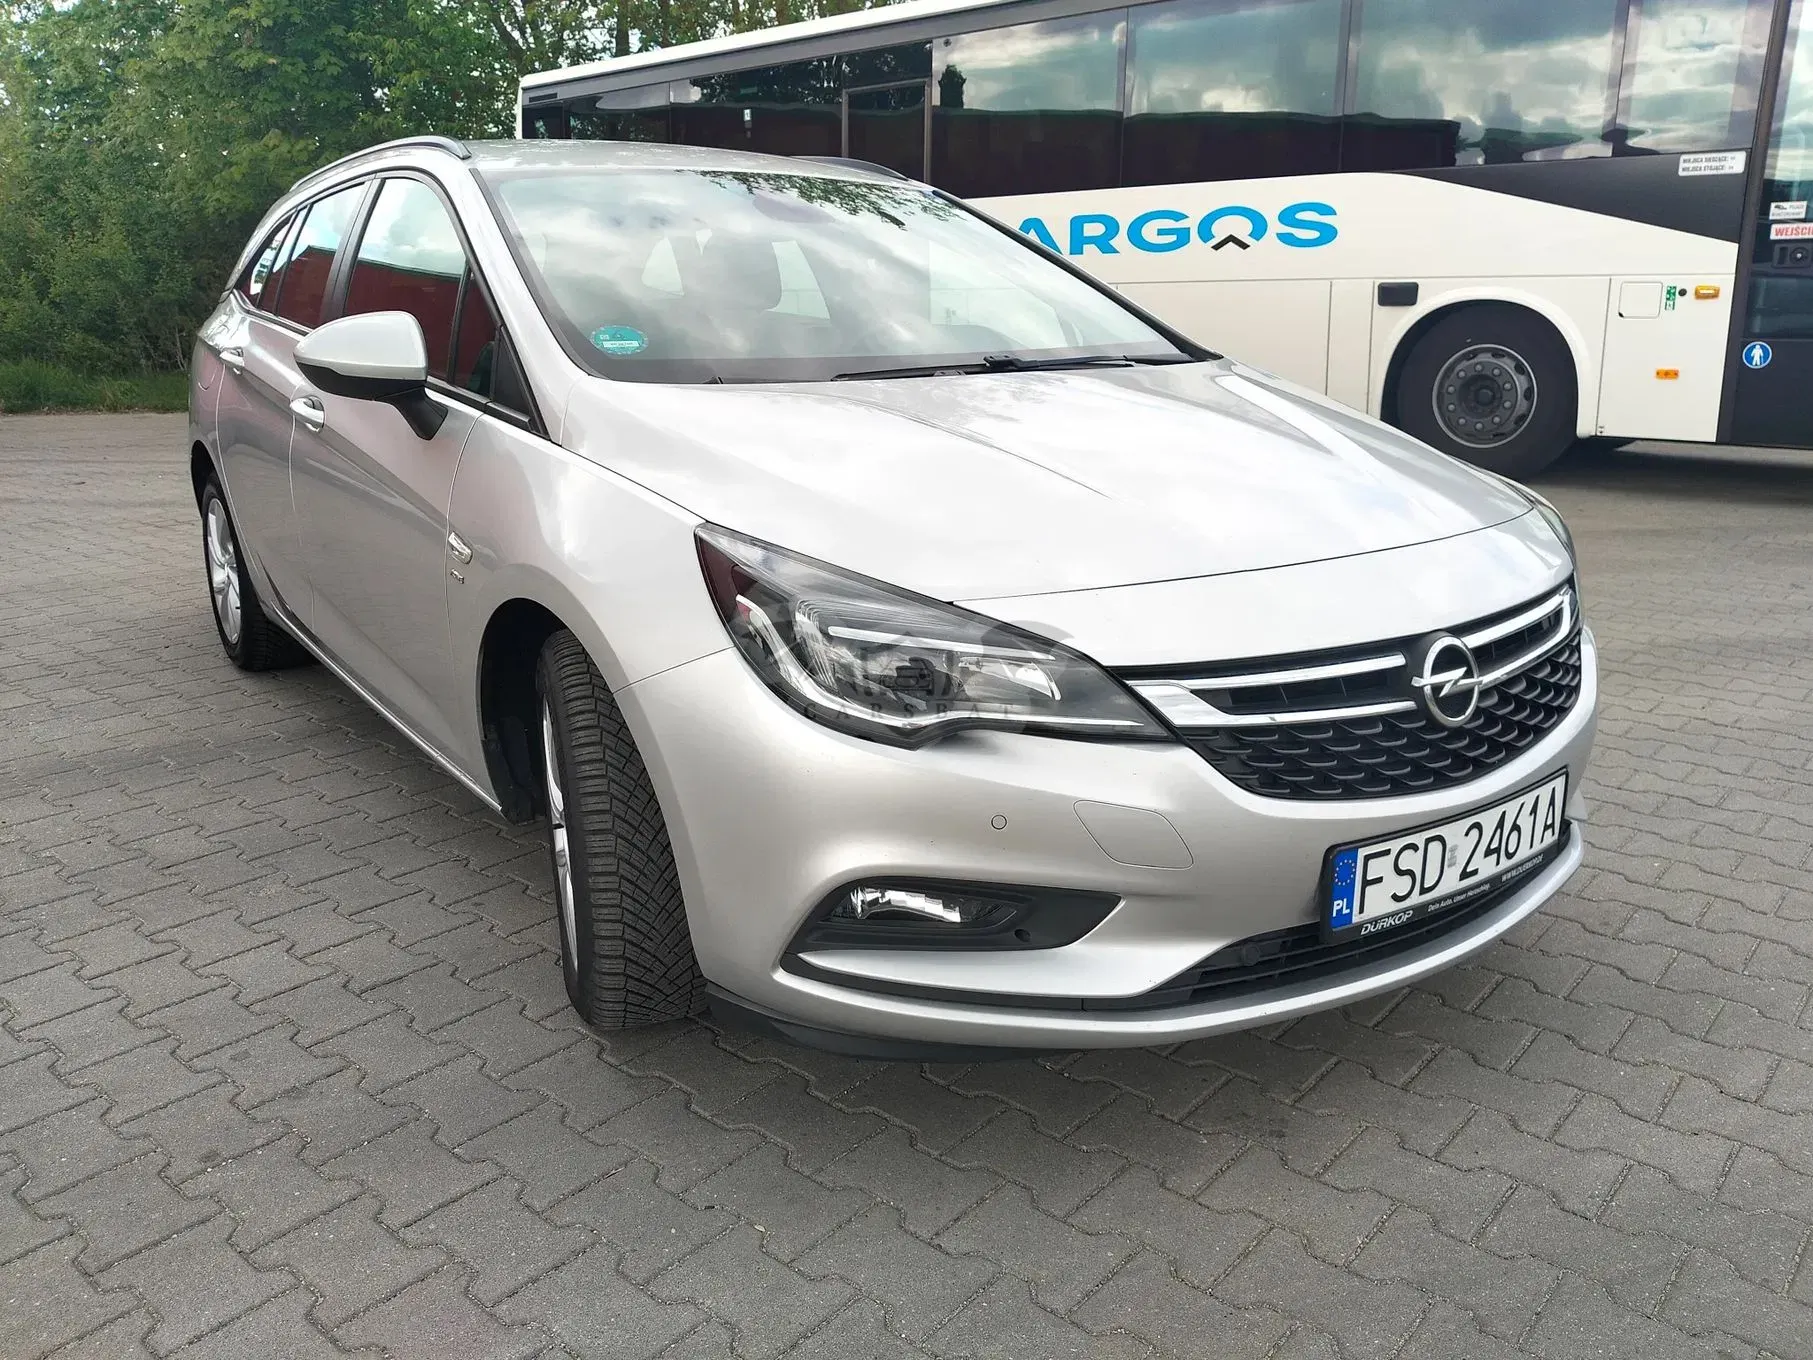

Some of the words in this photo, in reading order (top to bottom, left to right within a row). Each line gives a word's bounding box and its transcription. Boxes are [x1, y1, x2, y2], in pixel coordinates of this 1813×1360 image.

[1358, 834, 1447, 914] FSD
[1459, 786, 1556, 882] 2461A
[1332, 898, 1350, 917] PL
[1361, 910, 1413, 935] DÜRKOP
